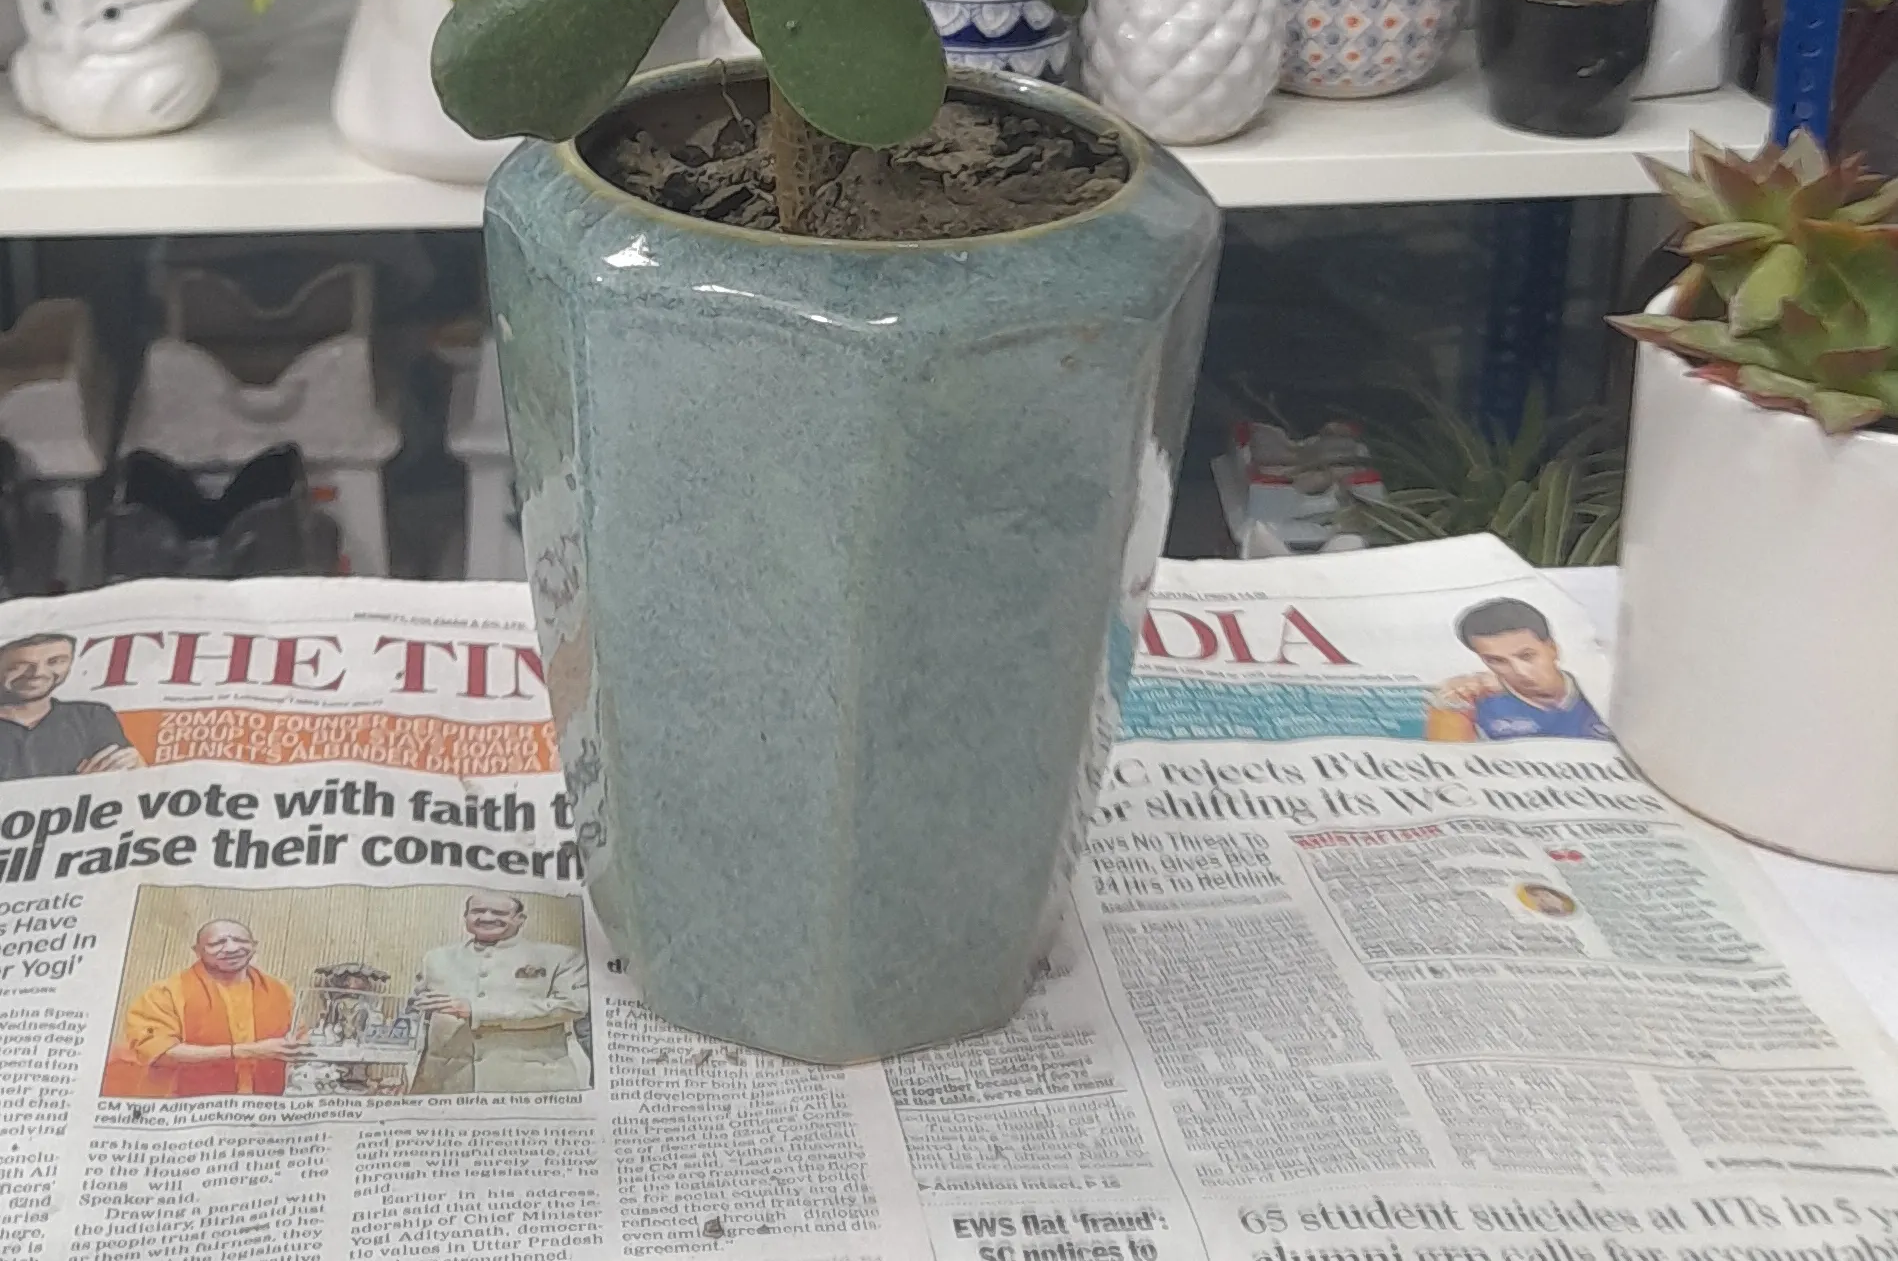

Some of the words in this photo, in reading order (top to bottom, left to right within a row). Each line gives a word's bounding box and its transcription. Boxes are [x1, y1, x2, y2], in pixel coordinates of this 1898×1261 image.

[79, 631, 347, 692] THE
[159, 709, 267, 730] ZOMATO
[273, 714, 388, 734] FOUNDER
[157, 724, 245, 745] GROUP
[312, 729, 359, 746] BUT
[453, 739, 538, 759] BOARD
[154, 742, 282, 764] BLINKIT'S
[288, 741, 419, 768] ALBINDER
[1158, 758, 1306, 789] rejects
[1310, 751, 1457, 781] B'desh
[1463, 754, 1640, 782] demand
[0, 794, 123, 845] ople
[138, 783, 259, 820] vote
[273, 778, 395, 819] with
[408, 790, 536, 832] faith
[1145, 788, 1318, 826] shifting
[1320, 788, 1381, 818] its
[1381, 783, 1477, 817] WC
[1482, 786, 1665, 813] matches
[55, 830, 197, 878] raise
[212, 823, 348, 869] their
[361, 834, 585, 881] concern
[1131, 831, 1163, 852] No
[1164, 832, 1239, 851] Threat
[1159, 854, 1223, 873] Gives
[1196, 867, 1286, 891] Rethink
[0, 892, 84, 916] ocratic
[13, 915, 78, 935] Have
[73, 933, 97, 950] In
[22, 954, 84, 980] Yogi'
[97, 1100, 122, 1112] CM
[160, 1098, 238, 1113] Adityanath
[242, 1099, 286, 1111] meets
[290, 1098, 314, 1110] Lok
[318, 1098, 362, 1109] Sabha
[366, 1097, 423, 1109] Speaker
[427, 1097, 452, 1107] Om
[455, 1095, 489, 1106] Birla
[491, 1096, 507, 1105] at
[509, 1094, 531, 1104] his
[534, 1094, 583, 1105] official
[94, 1113, 169, 1127] residence,
[173, 1114, 187, 1125] in
[190, 1112, 254, 1123] Lucknow
[258, 1113, 277, 1122] on
[281, 1109, 364, 1122] Wednesday
[148, 1179, 182, 1191] will
[463, 1211, 516, 1225] Chief
[521, 1210, 603, 1222] Minister
[953, 1216, 1017, 1238] EWS
[1021, 1213, 1070, 1236] flat
[1239, 1206, 1289, 1234] 65
[1299, 1194, 1466, 1232] student
[1471, 1197, 1645, 1233] suicides
[1648, 1203, 1689, 1233] at
[351, 1232, 390, 1246] Yogi
[471, 1238, 522, 1252] Uttar
[527, 1233, 604, 1249] Pradesh
